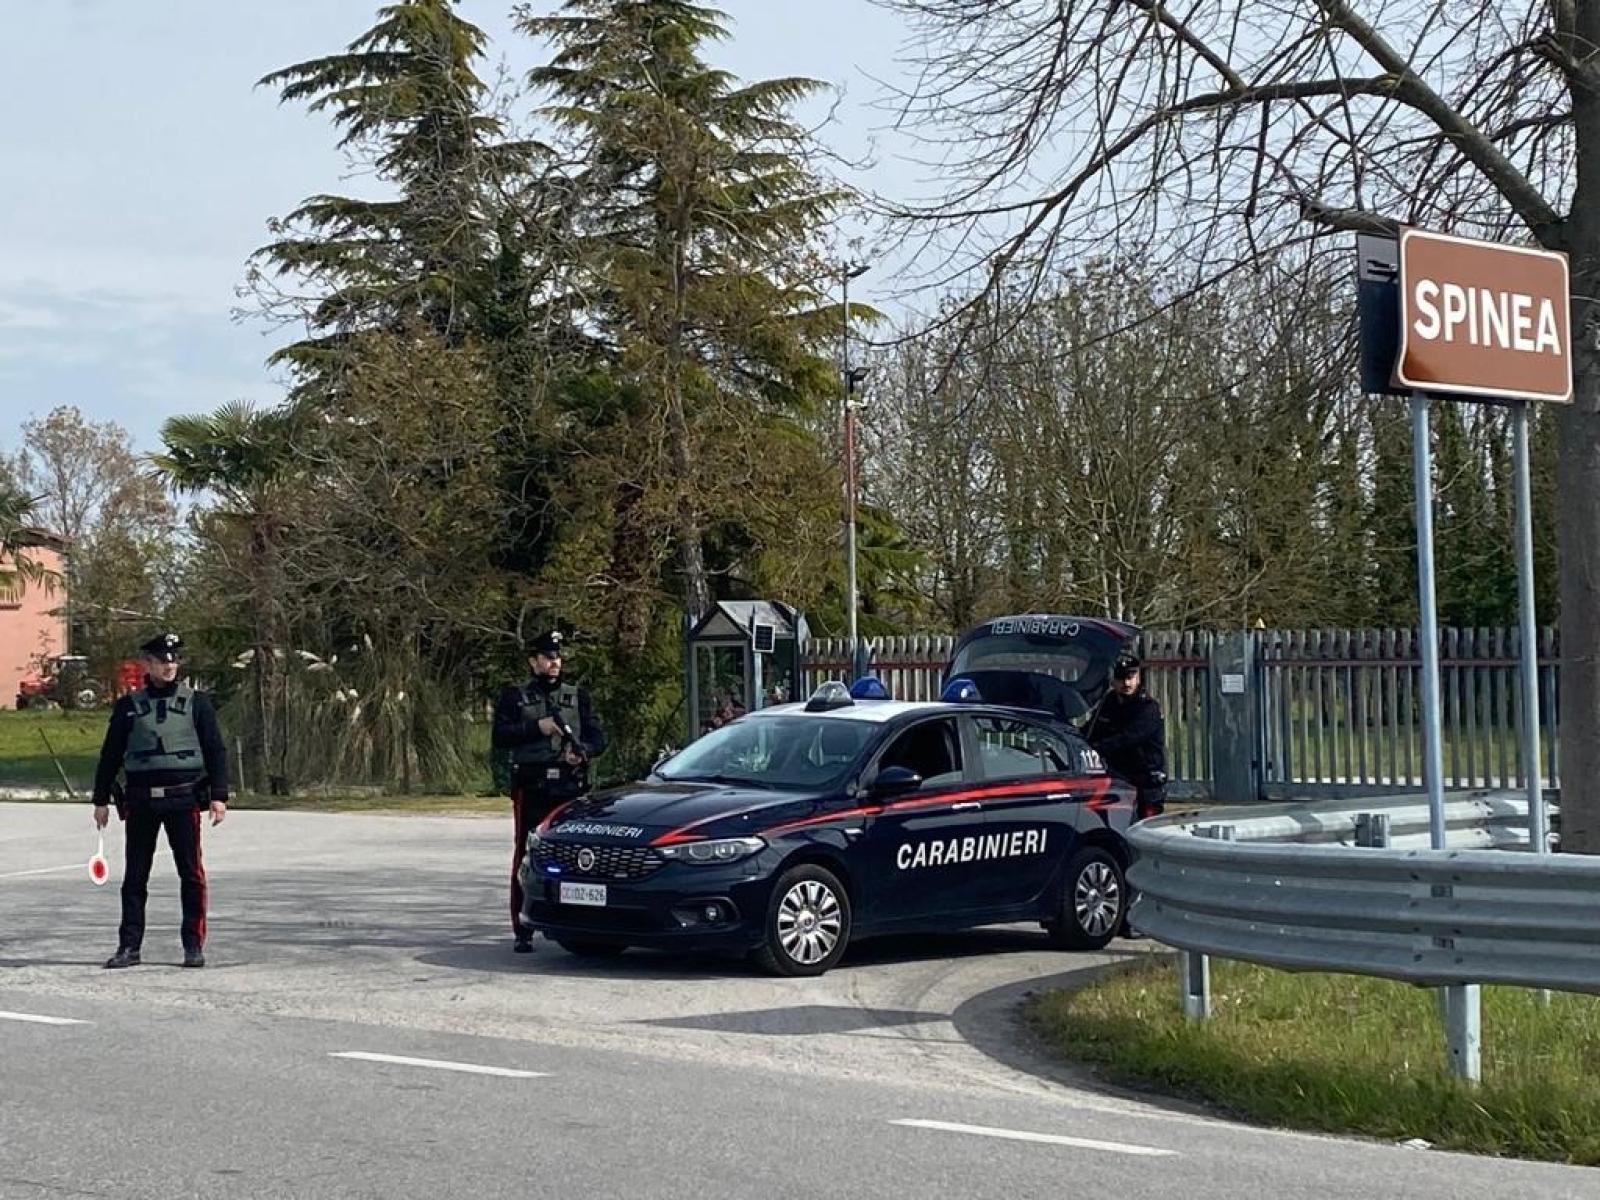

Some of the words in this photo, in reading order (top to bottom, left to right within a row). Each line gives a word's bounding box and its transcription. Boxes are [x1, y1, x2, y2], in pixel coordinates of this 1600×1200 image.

[1414, 279, 1561, 355] SPINEA
[991, 620, 1079, 636] CARABINIERI
[1080, 749, 1103, 768] 112
[556, 823, 643, 838] CARABINIERI
[897, 828, 1047, 869] CARABINIERI
